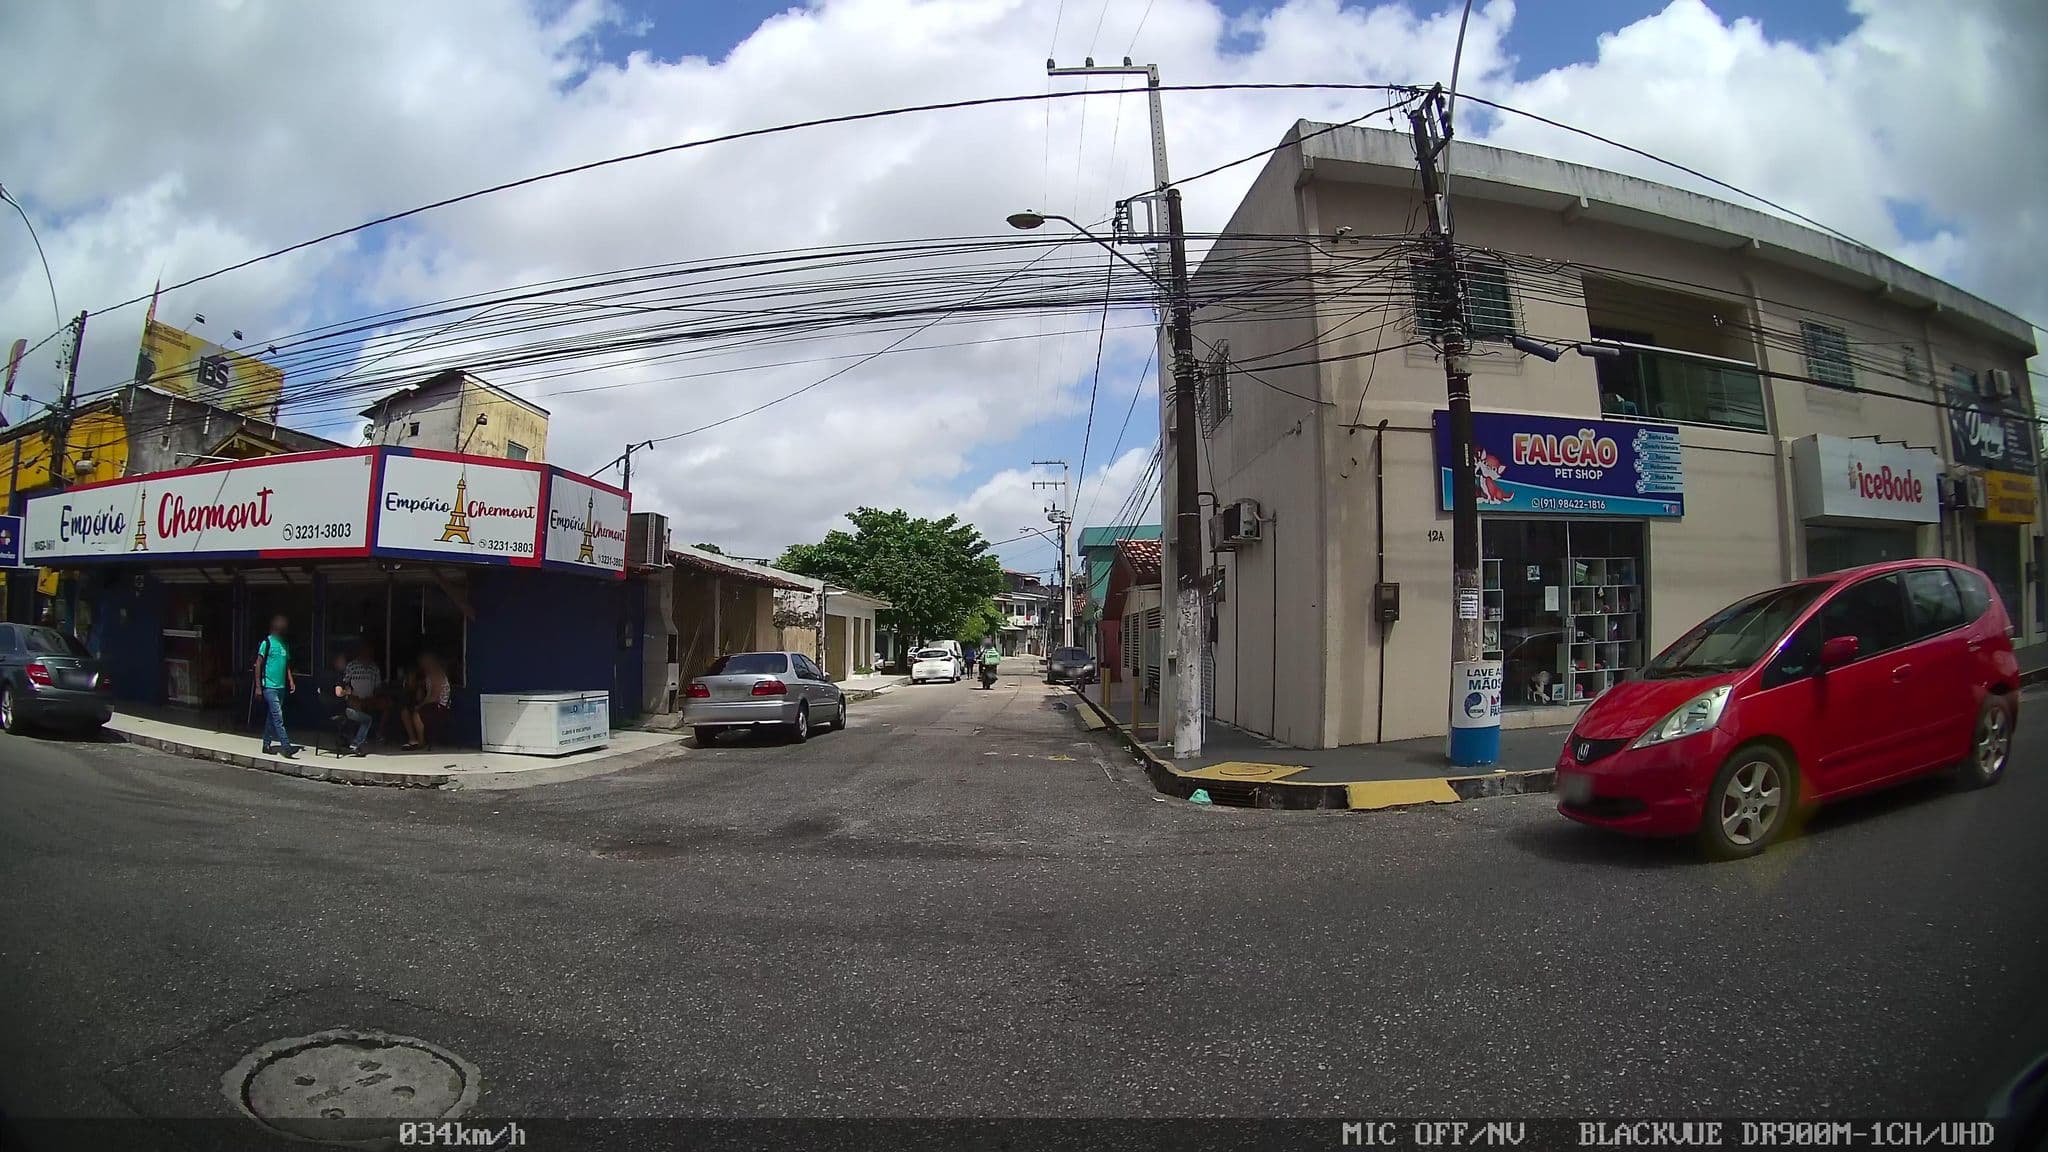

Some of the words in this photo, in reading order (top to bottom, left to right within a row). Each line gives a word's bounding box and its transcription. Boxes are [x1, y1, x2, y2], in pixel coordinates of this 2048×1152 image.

[1512, 428, 1618, 468] FALCÃO
[1554, 468, 1573, 479] PET
[1575, 468, 1603, 480] SHOP
[1857, 462, 1923, 503] iceBode
[385, 491, 451, 513] Empório
[467, 500, 536, 519] Chermont
[1540, 498, 1556, 509] (91)
[1558, 499, 1606, 510] 98422-1816
[61, 504, 126, 544] Empório
[157, 486, 274, 539] Chermont
[294, 523, 352, 540] 3231-3803
[550, 509, 586, 533] Empório
[592, 520, 626, 542] Chermont
[1427, 530, 1445, 542] 12A
[487, 538, 534, 554] 3231-3803
[1466, 668, 1494, 677] LAVE
[1495, 667, 1502, 676] A
